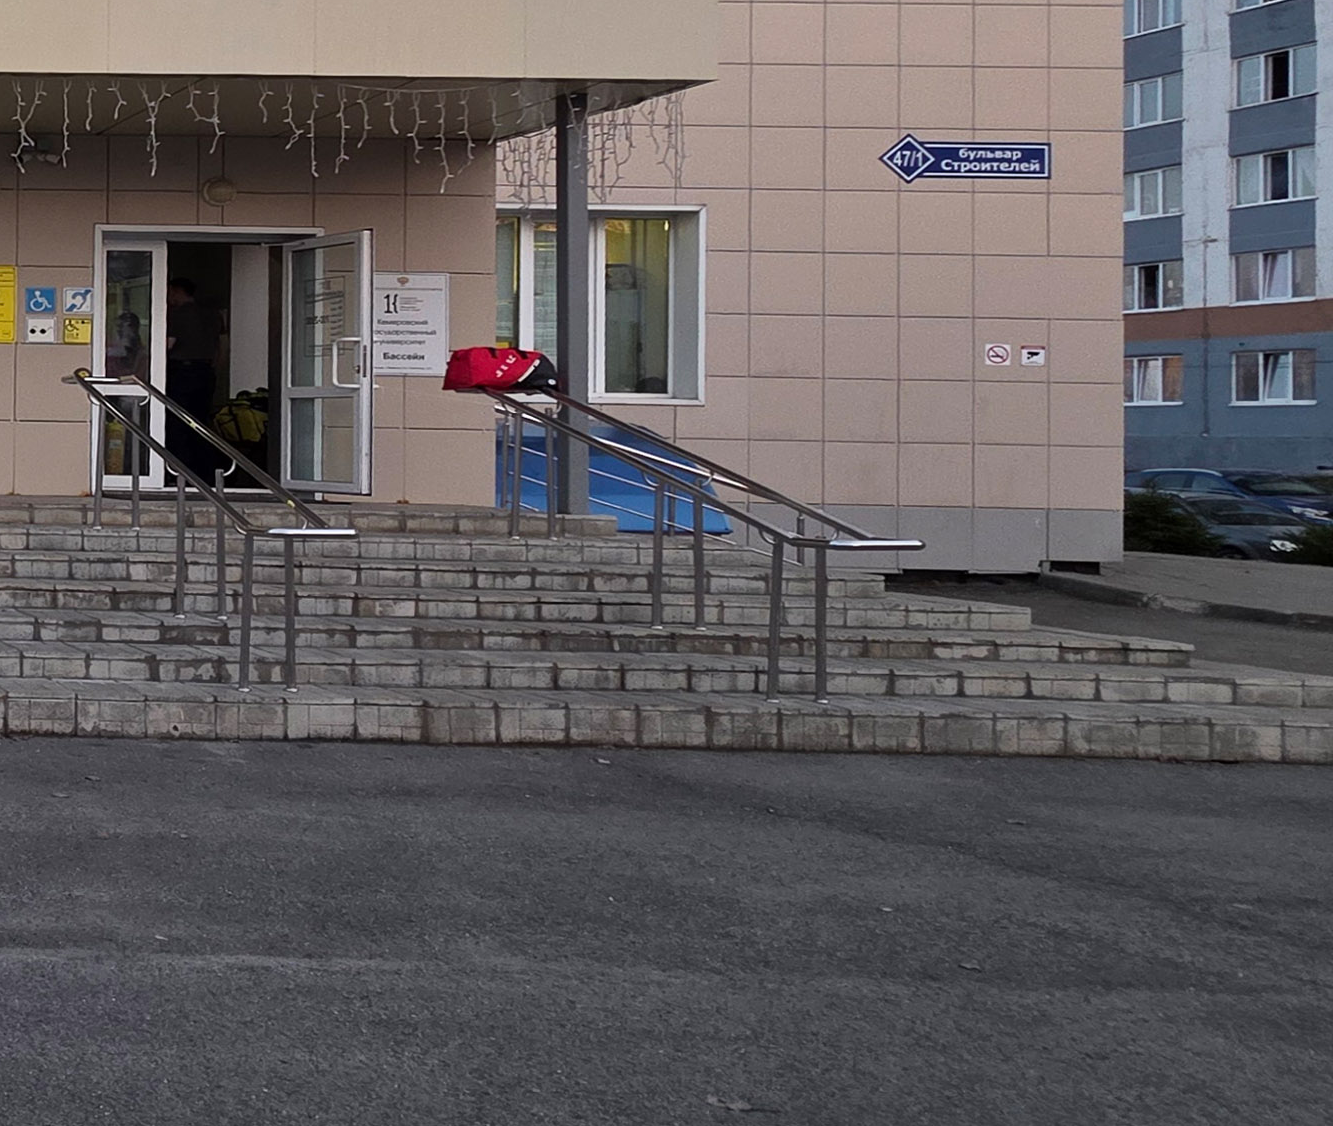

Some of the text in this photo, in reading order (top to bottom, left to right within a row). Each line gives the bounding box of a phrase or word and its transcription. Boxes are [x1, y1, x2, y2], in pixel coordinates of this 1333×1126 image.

[893, 150, 923, 167] 47/1
[958, 148, 1022, 161] бульвар
[940, 159, 1041, 172] Строителей
[383, 352, 425, 360] Бассейн
